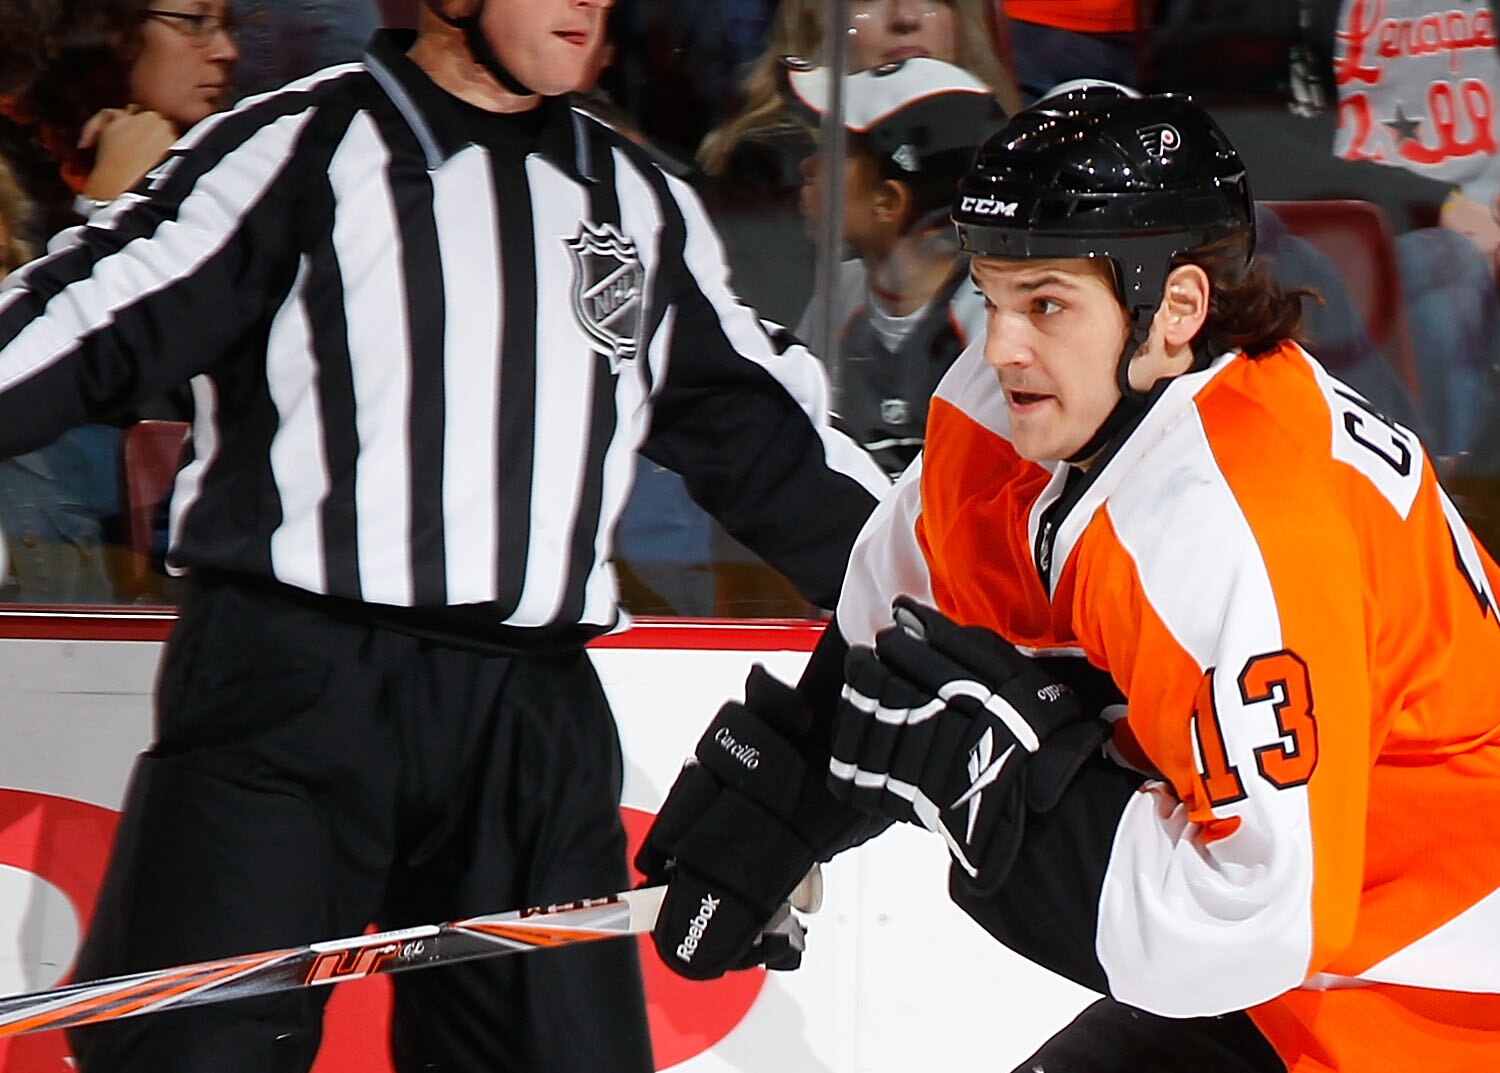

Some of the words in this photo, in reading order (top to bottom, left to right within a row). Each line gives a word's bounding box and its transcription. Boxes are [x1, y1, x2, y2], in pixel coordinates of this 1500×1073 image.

[961, 196, 1019, 217] CCM
[714, 727, 760, 770] Carcillo
[1190, 648, 1319, 808] 13
[676, 893, 721, 963] Reebok
